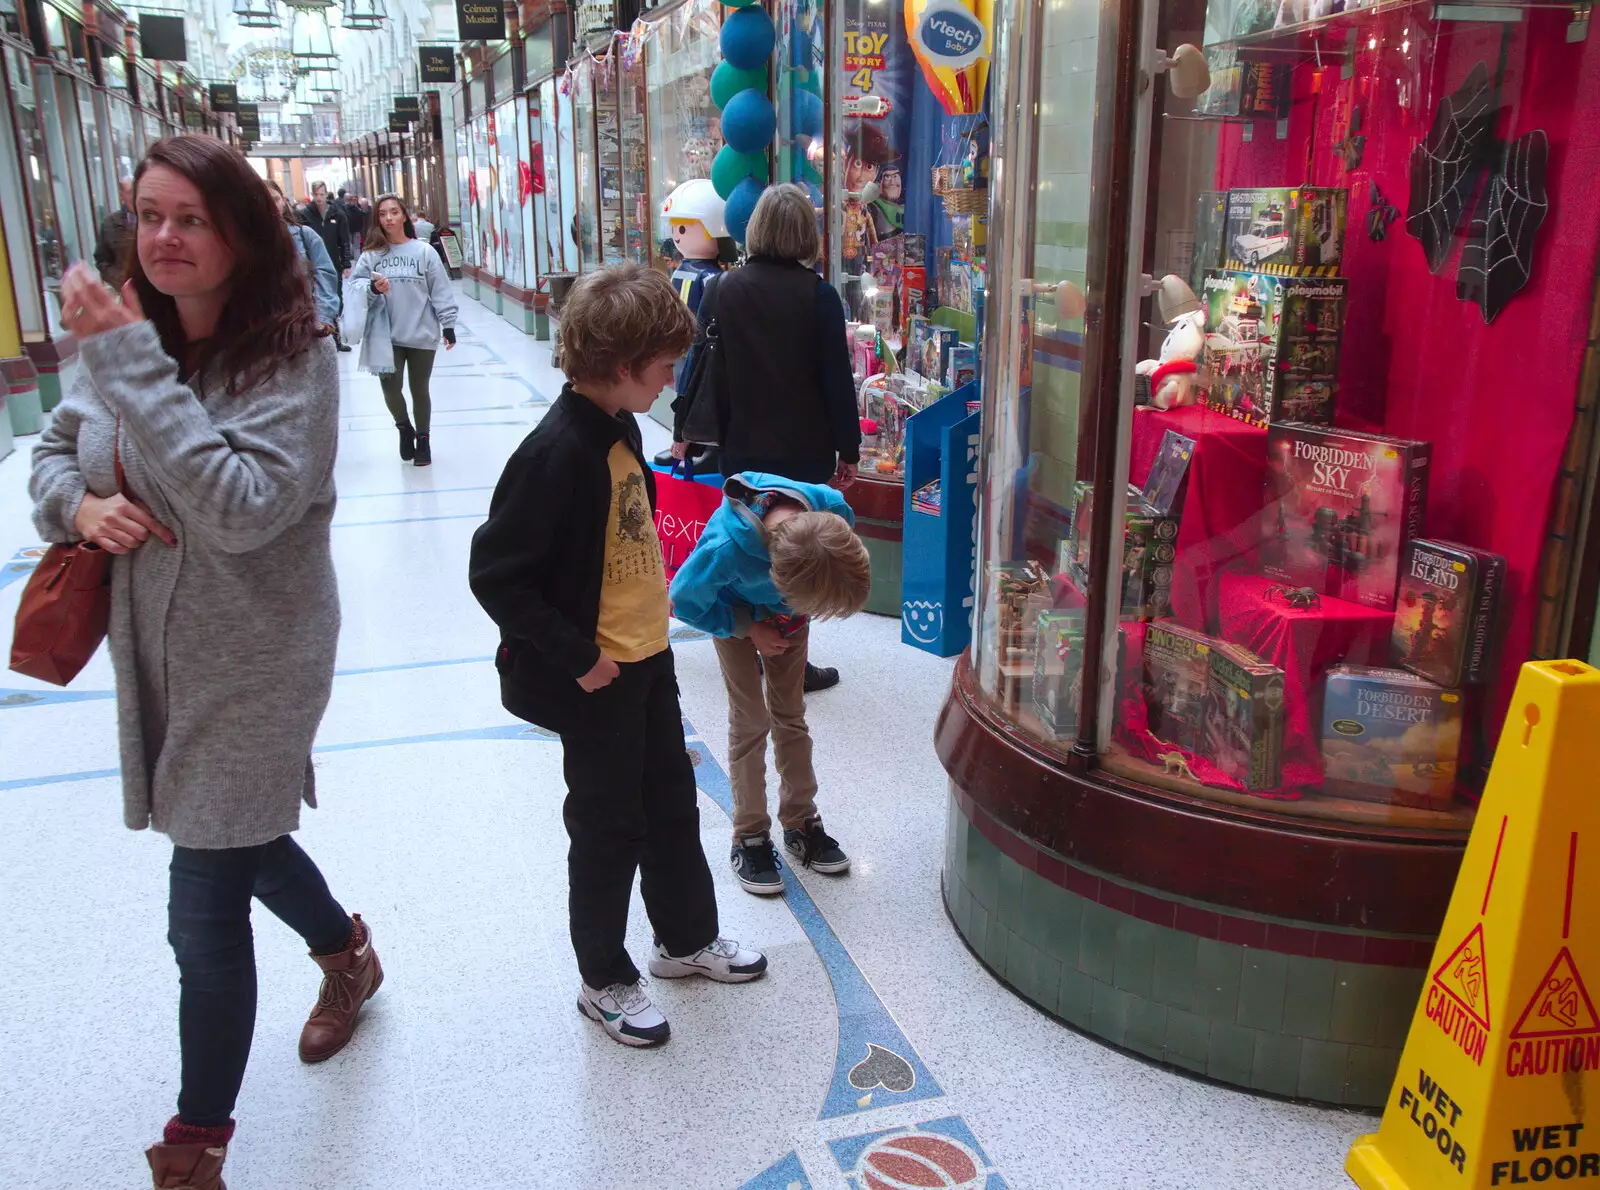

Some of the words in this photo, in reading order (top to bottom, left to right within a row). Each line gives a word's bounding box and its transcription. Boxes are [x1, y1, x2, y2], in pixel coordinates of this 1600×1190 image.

[463, 4, 497, 13] Colmans
[465, 14, 497, 24] Mustard
[867, 20, 887, 28] PIXAR
[929, 17, 975, 46] vtech
[843, 31, 889, 55] TOY
[945, 39, 968, 54] Baby
[426, 64, 450, 73] Tannery
[846, 56, 882, 67] STORY
[851, 66, 874, 93] 4
[373, 256, 424, 277] COLONIAL
[1287, 284, 1345, 298] playmobil
[1294, 440, 1374, 470] FORBIDDEN
[1312, 461, 1351, 490] SKY
[1413, 548, 1456, 574] FORBIDDE
[1410, 559, 1459, 590] ISLAND
[1357, 688, 1433, 708] FORBIDDEN
[1356, 700, 1433, 723] DESERT
[1425, 984, 1488, 1067] CAUTION
[1506, 1036, 1600, 1077] CAUTION
[1418, 1067, 1463, 1128] WET
[1399, 1085, 1467, 1176] FLOOR
[1512, 1122, 1584, 1152] WET
[1491, 1153, 1600, 1186] FLOOR
